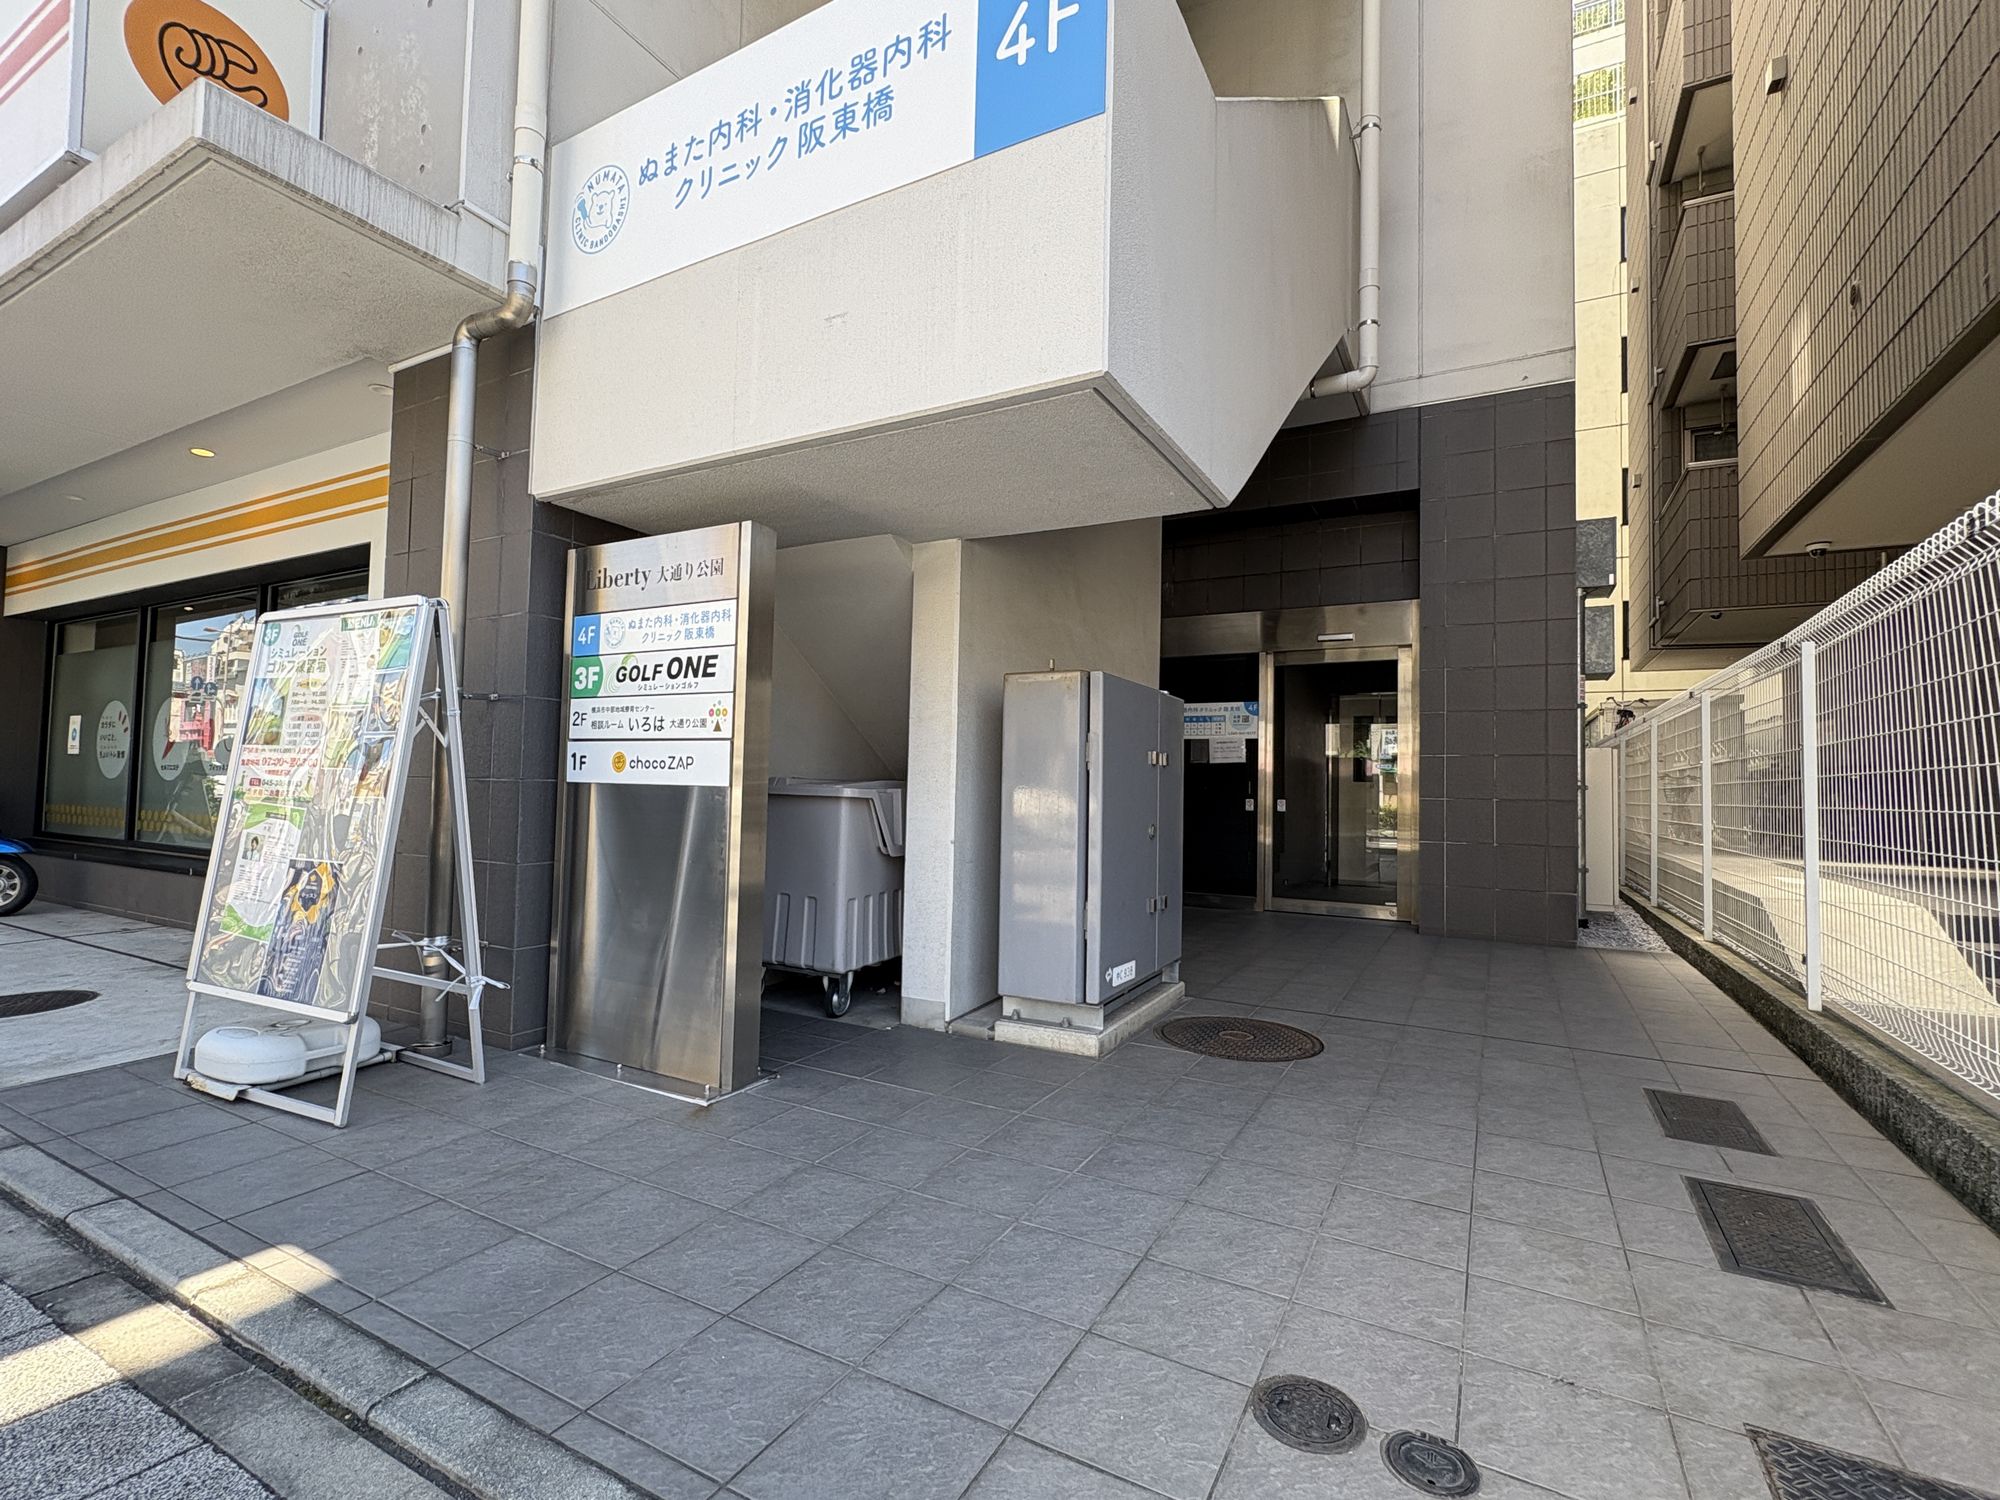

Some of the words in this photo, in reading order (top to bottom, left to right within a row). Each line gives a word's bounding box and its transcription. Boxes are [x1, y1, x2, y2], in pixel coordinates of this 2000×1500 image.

[638, 12, 953, 187] ぬまた内科・消化器内科
[587, 170, 626, 194] NUMATA
[575, 217, 589, 248] CLINIC
[589, 196, 627, 250] BANDOBASHI
[586, 568, 652, 592] Liberty
[657, 557, 724, 583] 大通り公園
[628, 607, 732, 630] ぬまた内科・消化器内科
[264, 628, 279, 642] 3F
[291, 638, 308, 647] ONE
[577, 626, 596, 645] 4F
[270, 646, 328, 659] シミュレーション
[574, 665, 600, 690] 3F
[615, 663, 663, 683] GOLF
[667, 655, 719, 678] ONE
[637, 682, 699, 691] シミュレーションゴルフ
[572, 711, 588, 727] 2F
[591, 720, 624, 730] 相談ルーム
[628, 716, 665, 733] いろは
[669, 718, 708, 729] 大通り公園
[571, 752, 587, 771] 1F
